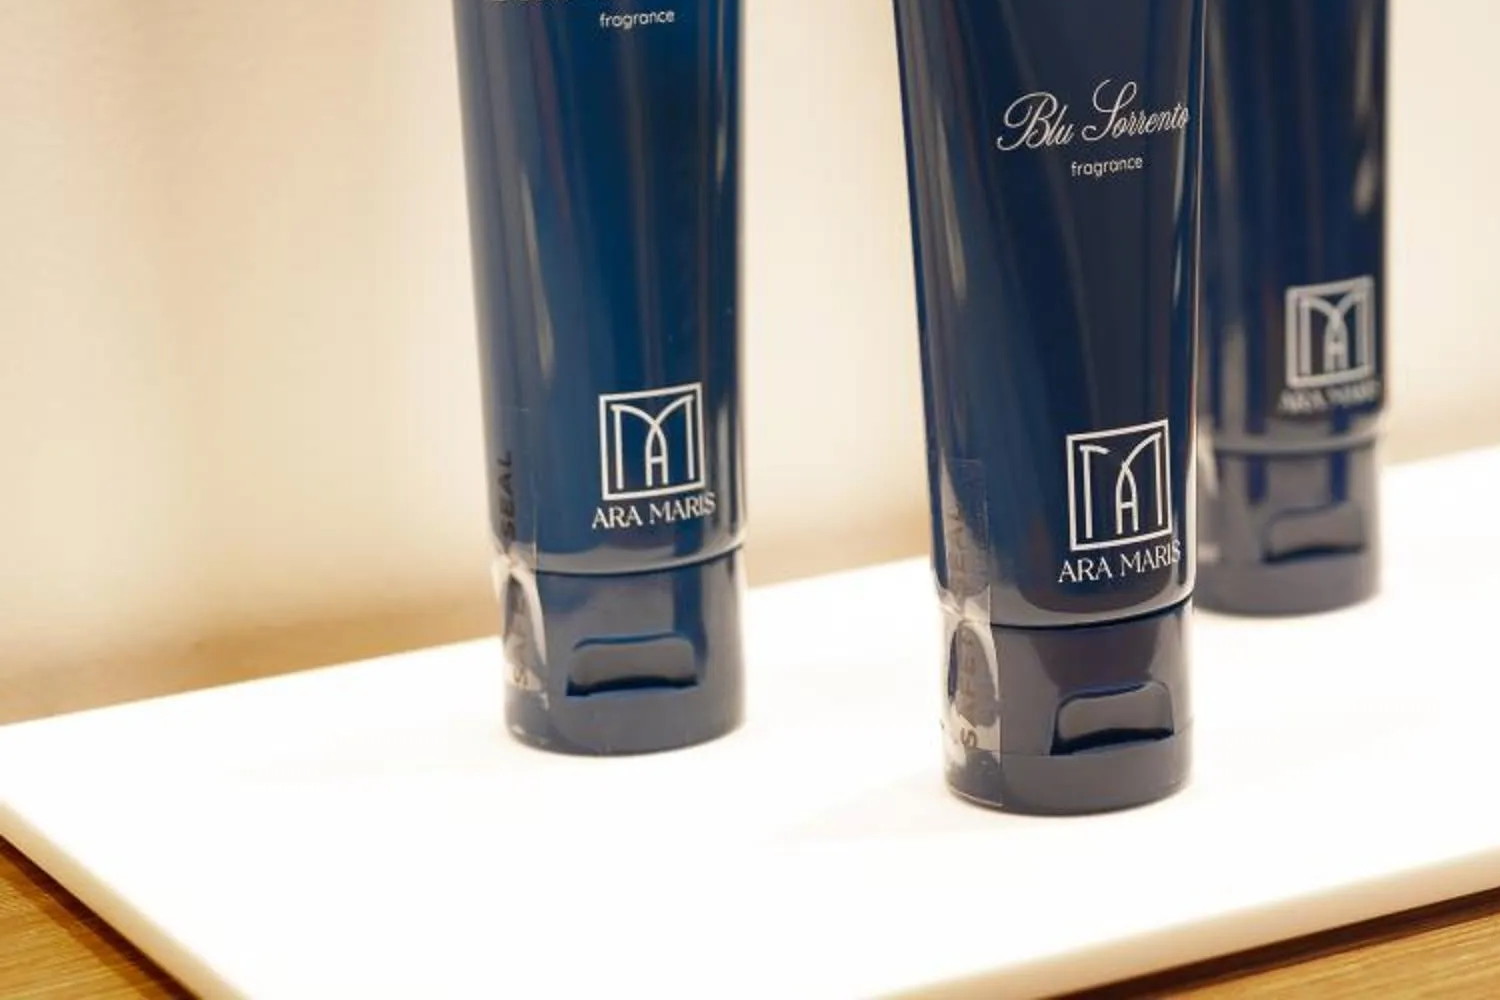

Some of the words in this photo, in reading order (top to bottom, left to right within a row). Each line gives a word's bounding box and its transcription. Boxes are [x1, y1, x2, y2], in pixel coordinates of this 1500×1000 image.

[600, 10, 676, 30] fragrance
[996, 91, 1075, 151] Blu
[1081, 79, 1190, 141] Sorrento
[1071, 156, 1144, 177] fragrance
[591, 506, 643, 529] ARA
[649, 491, 717, 525] MARIS
[1058, 557, 1113, 583] ARA
[1120, 539, 1181, 577] MARIS
